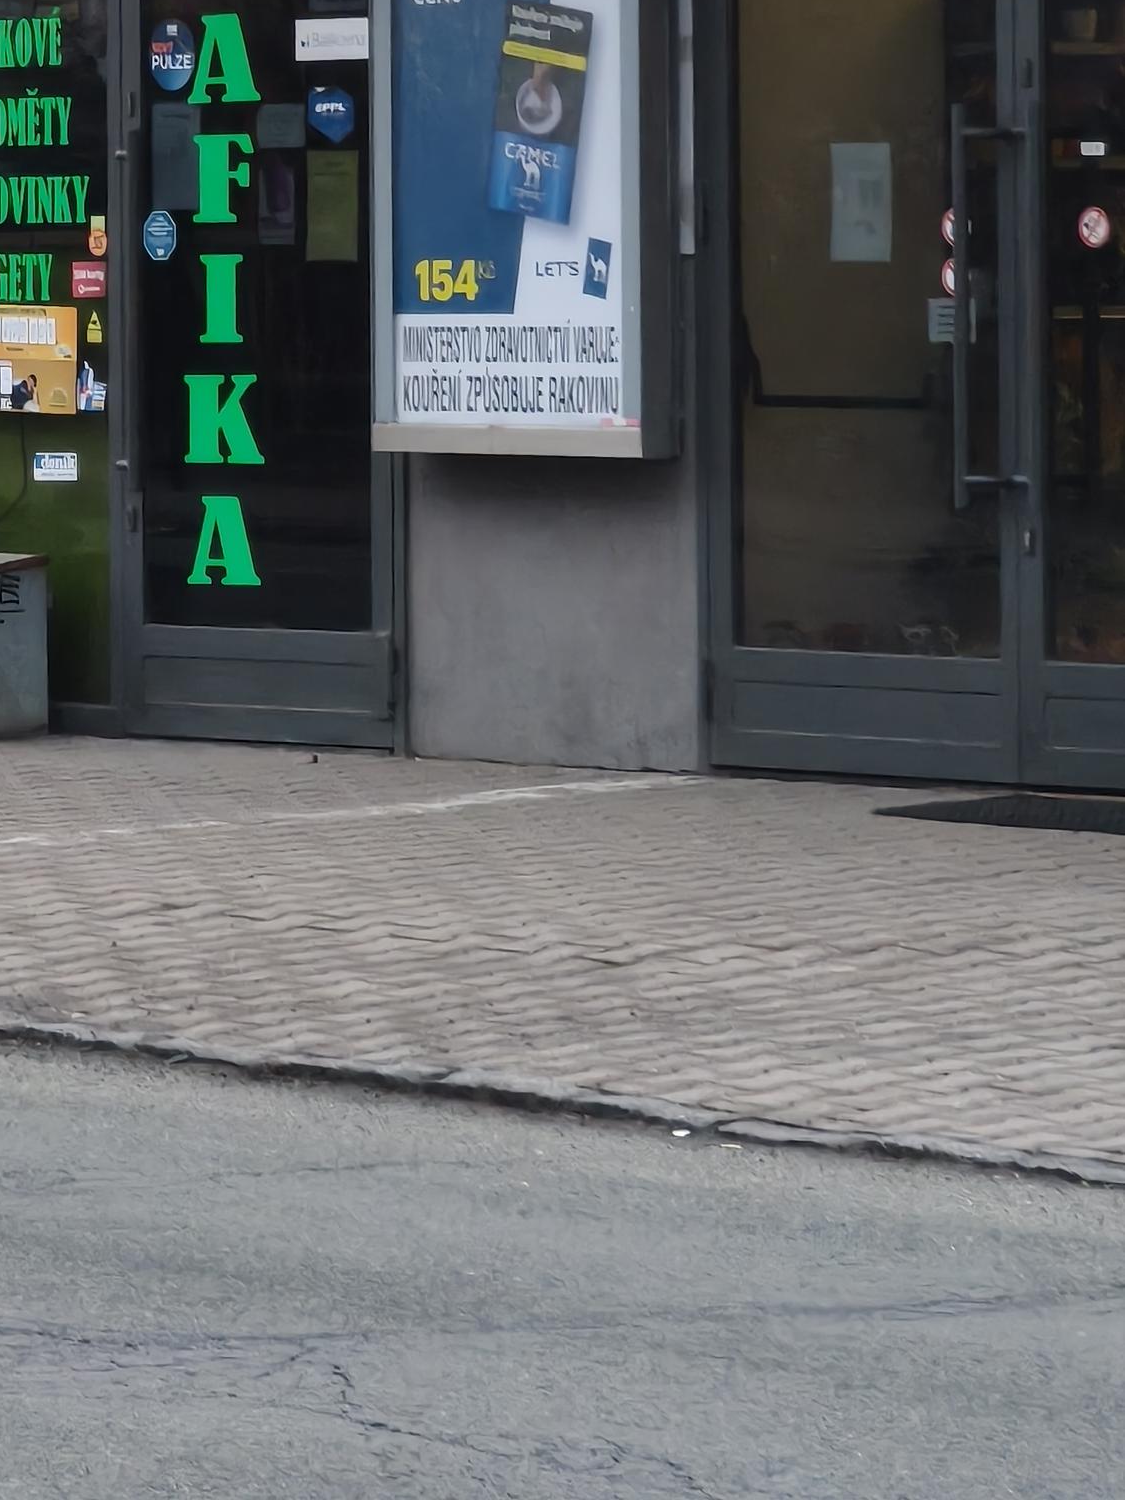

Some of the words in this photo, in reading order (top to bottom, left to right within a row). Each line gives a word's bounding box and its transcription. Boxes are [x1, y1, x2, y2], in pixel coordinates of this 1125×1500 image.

[151, 52, 192, 71] PULZE
[504, 142, 561, 170] CAMEL
[415, 259, 479, 302] 154
[403, 326, 482, 363] MINISTERSTVO
[485, 319, 570, 363] ZDRAVOTNICTVÍ
[403, 368, 462, 412] KOUŘENÍ
[549, 375, 619, 414] RAKOVINU
